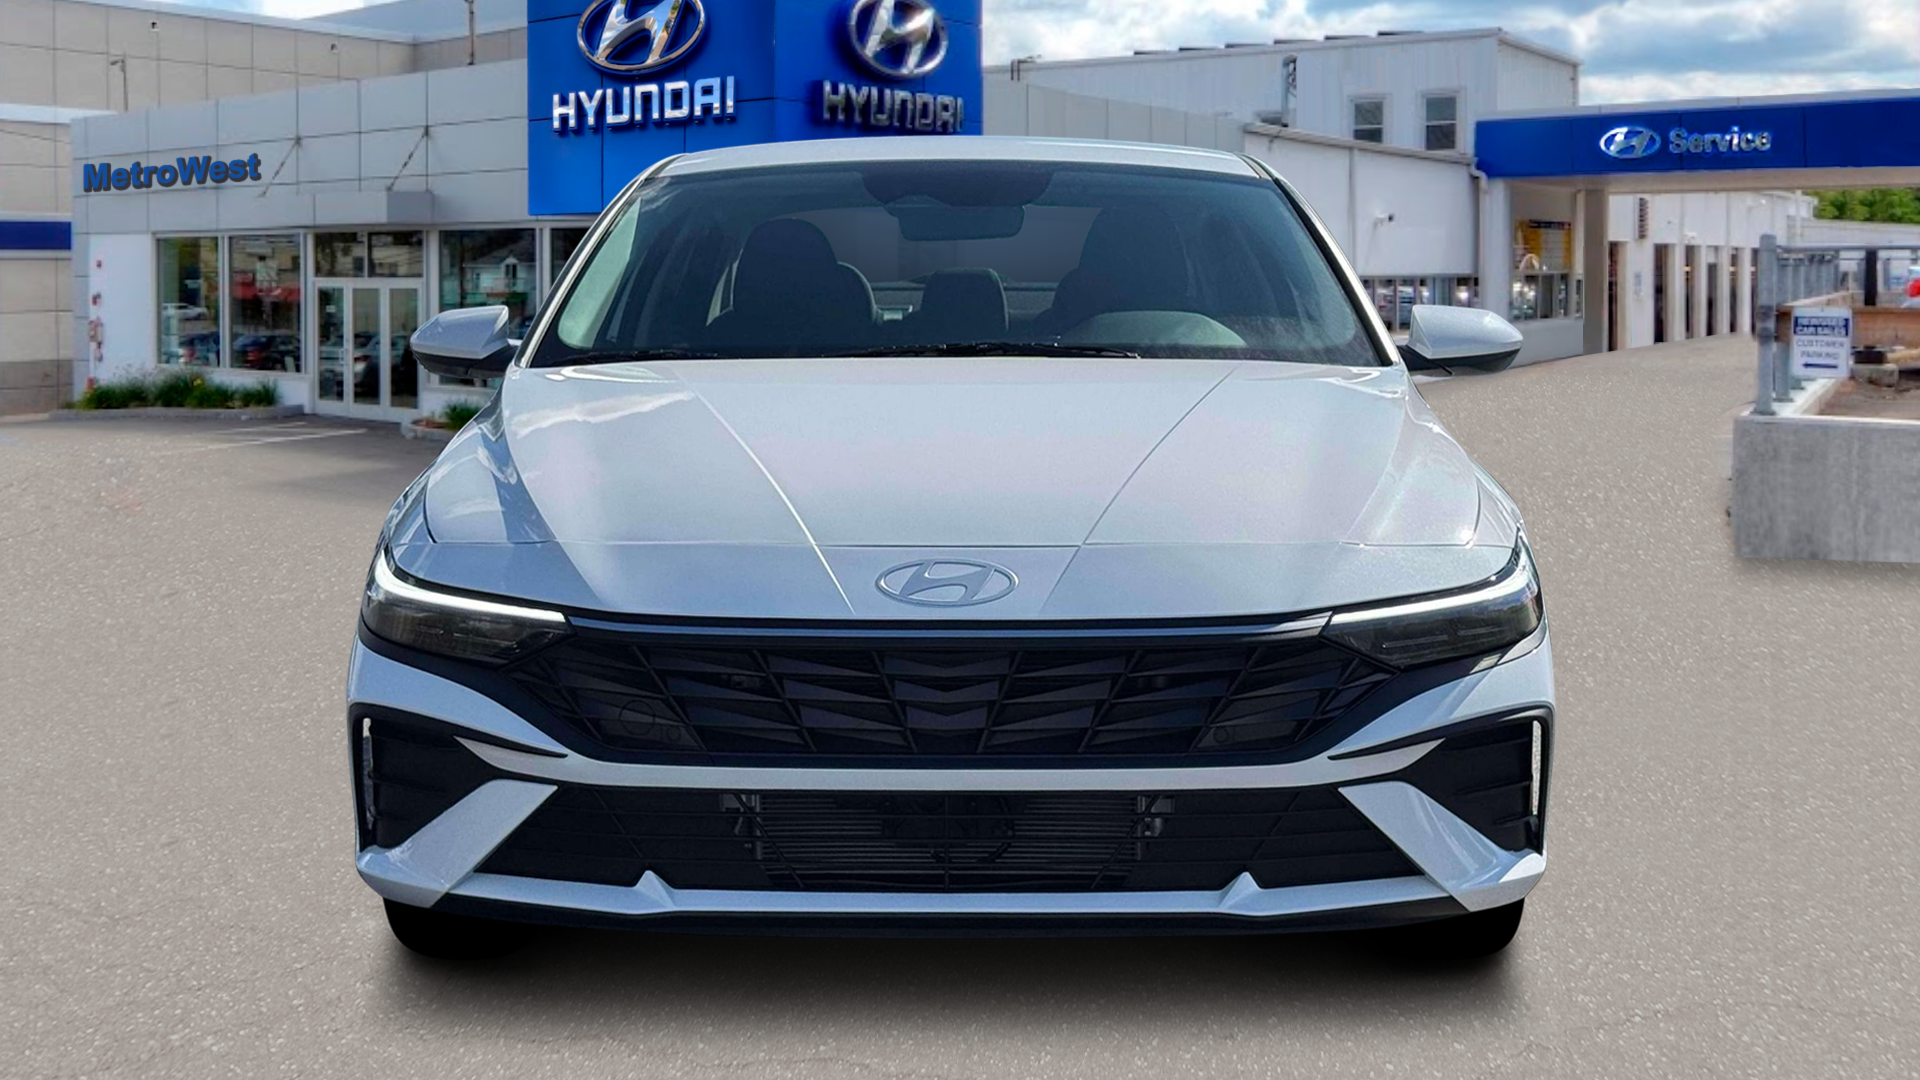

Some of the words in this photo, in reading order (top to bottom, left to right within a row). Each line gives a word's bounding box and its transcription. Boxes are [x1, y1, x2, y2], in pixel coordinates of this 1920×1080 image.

[552, 75, 735, 130] HYUNDAI
[822, 80, 965, 133] HYUNDAI
[1669, 125, 1772, 153] Service
[83, 152, 262, 193] MetroWest
[1797, 339, 1845, 348] CUSTOMER
